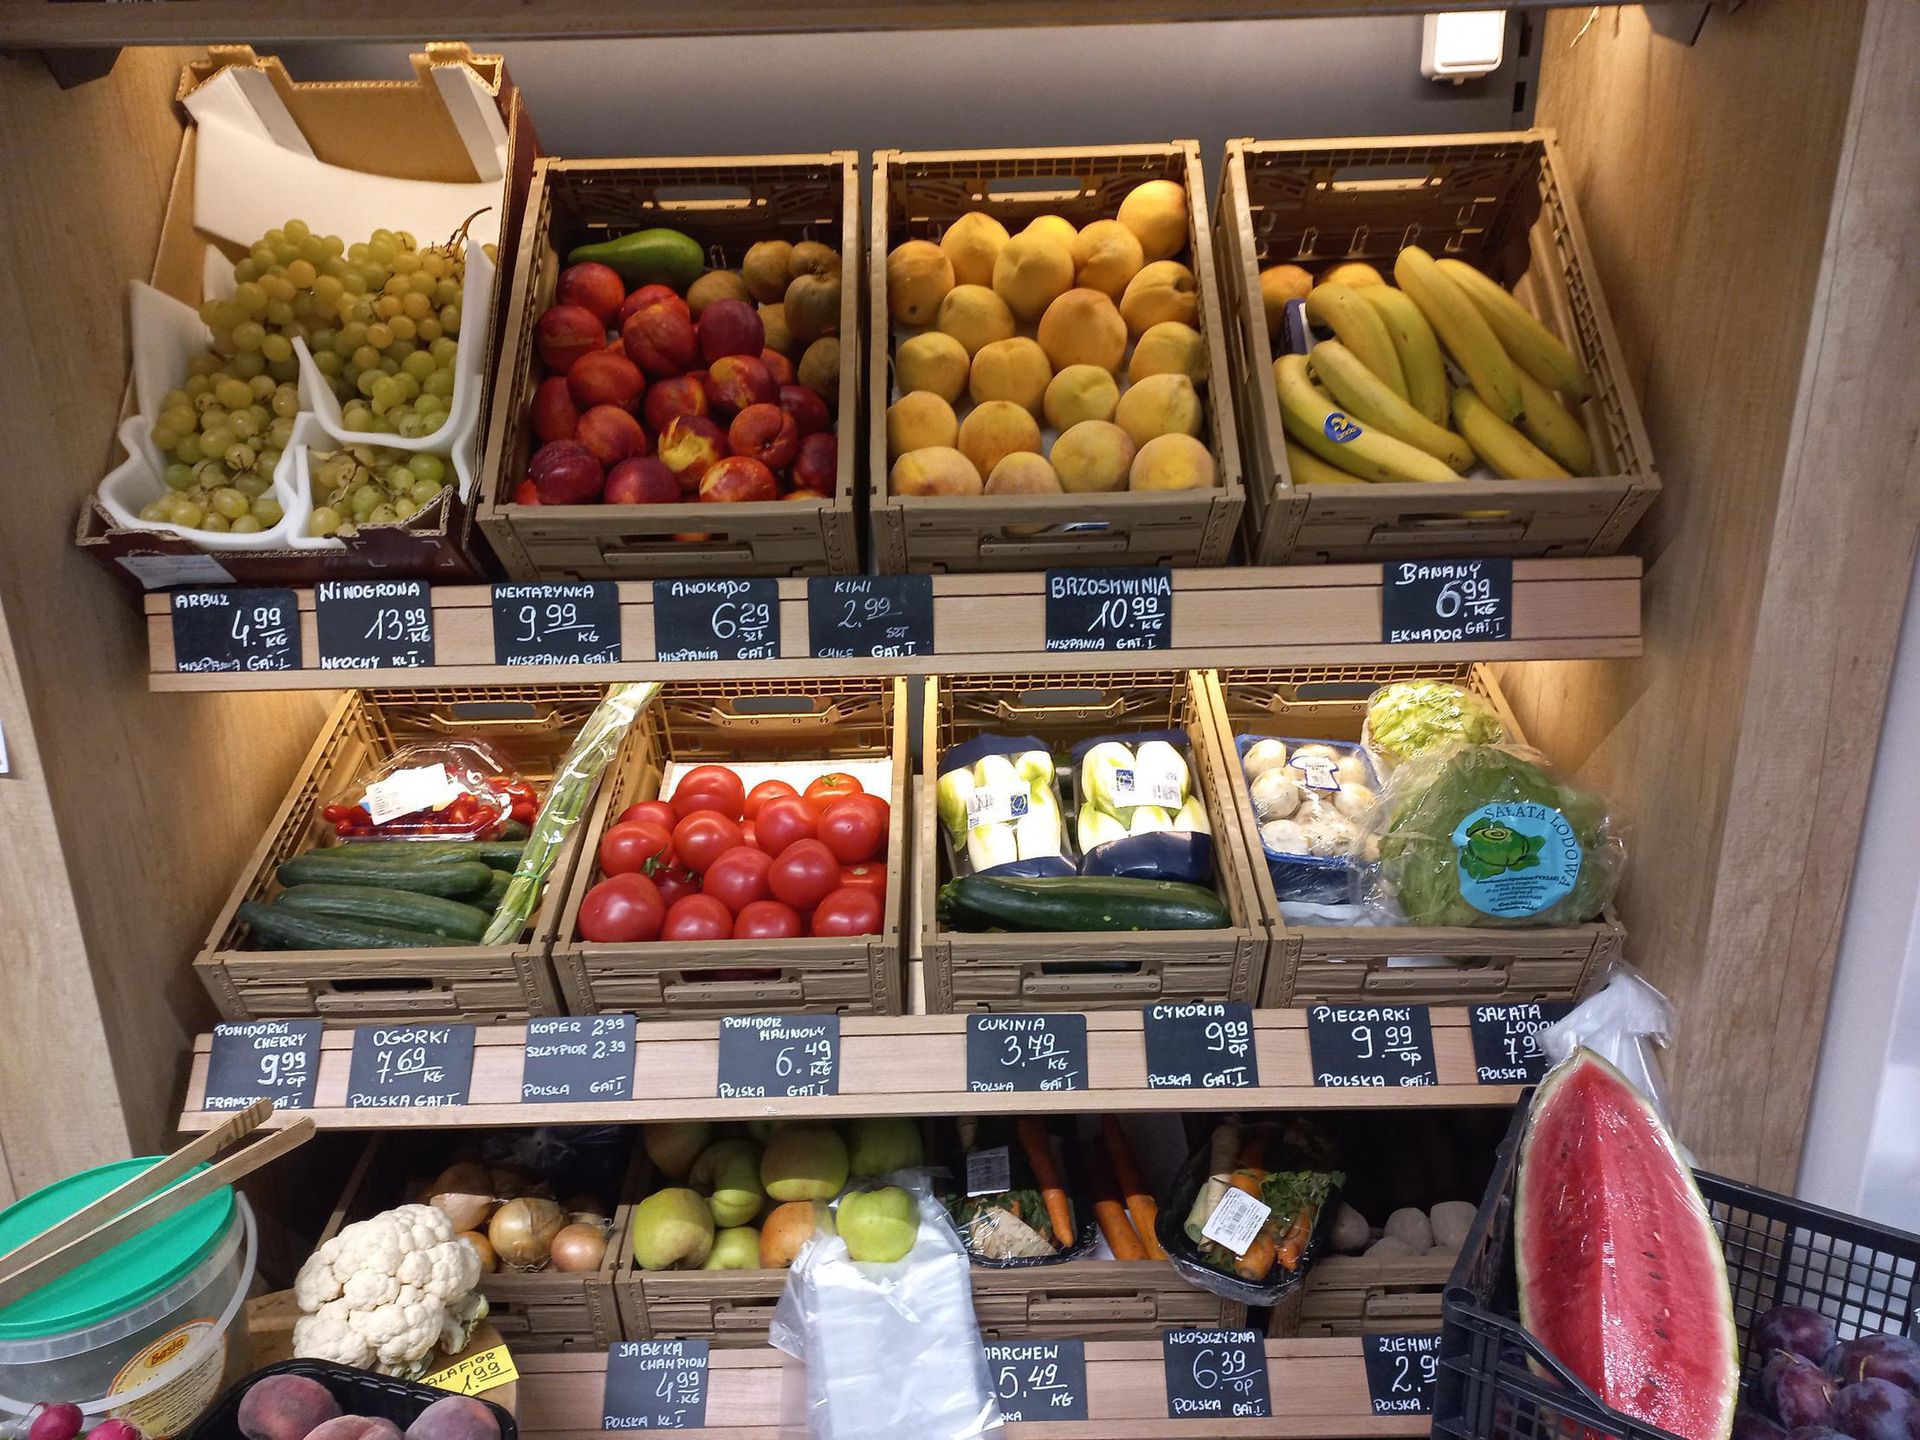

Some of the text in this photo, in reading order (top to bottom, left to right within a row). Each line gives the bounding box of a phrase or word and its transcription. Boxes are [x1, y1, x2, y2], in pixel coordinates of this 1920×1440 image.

[1395, 560, 1483, 585] BANANY
[495, 584, 595, 599] NEKTARYNKA
[834, 580, 872, 593] KIWI
[1051, 576, 1172, 599] BRZOSKWINIA
[175, 593, 230, 608] ARBUZ
[1474, 603, 1497, 616] KG
[1141, 619, 1163, 630] KG
[265, 633, 289, 648] KG
[577, 630, 600, 642] KG
[1046, 638, 1105, 650] HISZPANIA
[506, 653, 580, 666] HISZPANIA
[817, 647, 855, 658] CHILE
[1484, 805, 1580, 888] SAŁATA LODOWA
[1153, 1004, 1226, 1020] CYKORIA
[1476, 1004, 1542, 1022] SAŁATA
[530, 1022, 582, 1034] KOPER
[978, 1017, 1046, 1031] CUKINIA
[1505, 1020, 1556, 1035] LODO
[254, 1033, 308, 1049] CHERRY
[1503, 1035, 1543, 1064] 7.9
[810, 1062, 833, 1076] KG
[1048, 1058, 1069, 1070] KG
[423, 1071, 446, 1083] KG
[1318, 1073, 1386, 1087] POLSKA
[1477, 1066, 1528, 1080] POLSKA
[970, 1080, 1015, 1092] POLSKA
[1148, 1073, 1192, 1088] POLSKA
[522, 1083, 570, 1097] POLSKA
[718, 1083, 765, 1099] POLSKA
[349, 1093, 411, 1108] POLSKA
[424, 1351, 495, 1387] ALAFIOR
[640, 1358, 707, 1371] CHAMPION
[1391, 1355, 1440, 1393] 2.9
[680, 1393, 700, 1404] KG
[1050, 1392, 1074, 1406] KG
[1171, 1397, 1222, 1414] POLSKA
[1373, 1398, 1421, 1412] POLSKA
[604, 1416, 648, 1429] POLSKA
